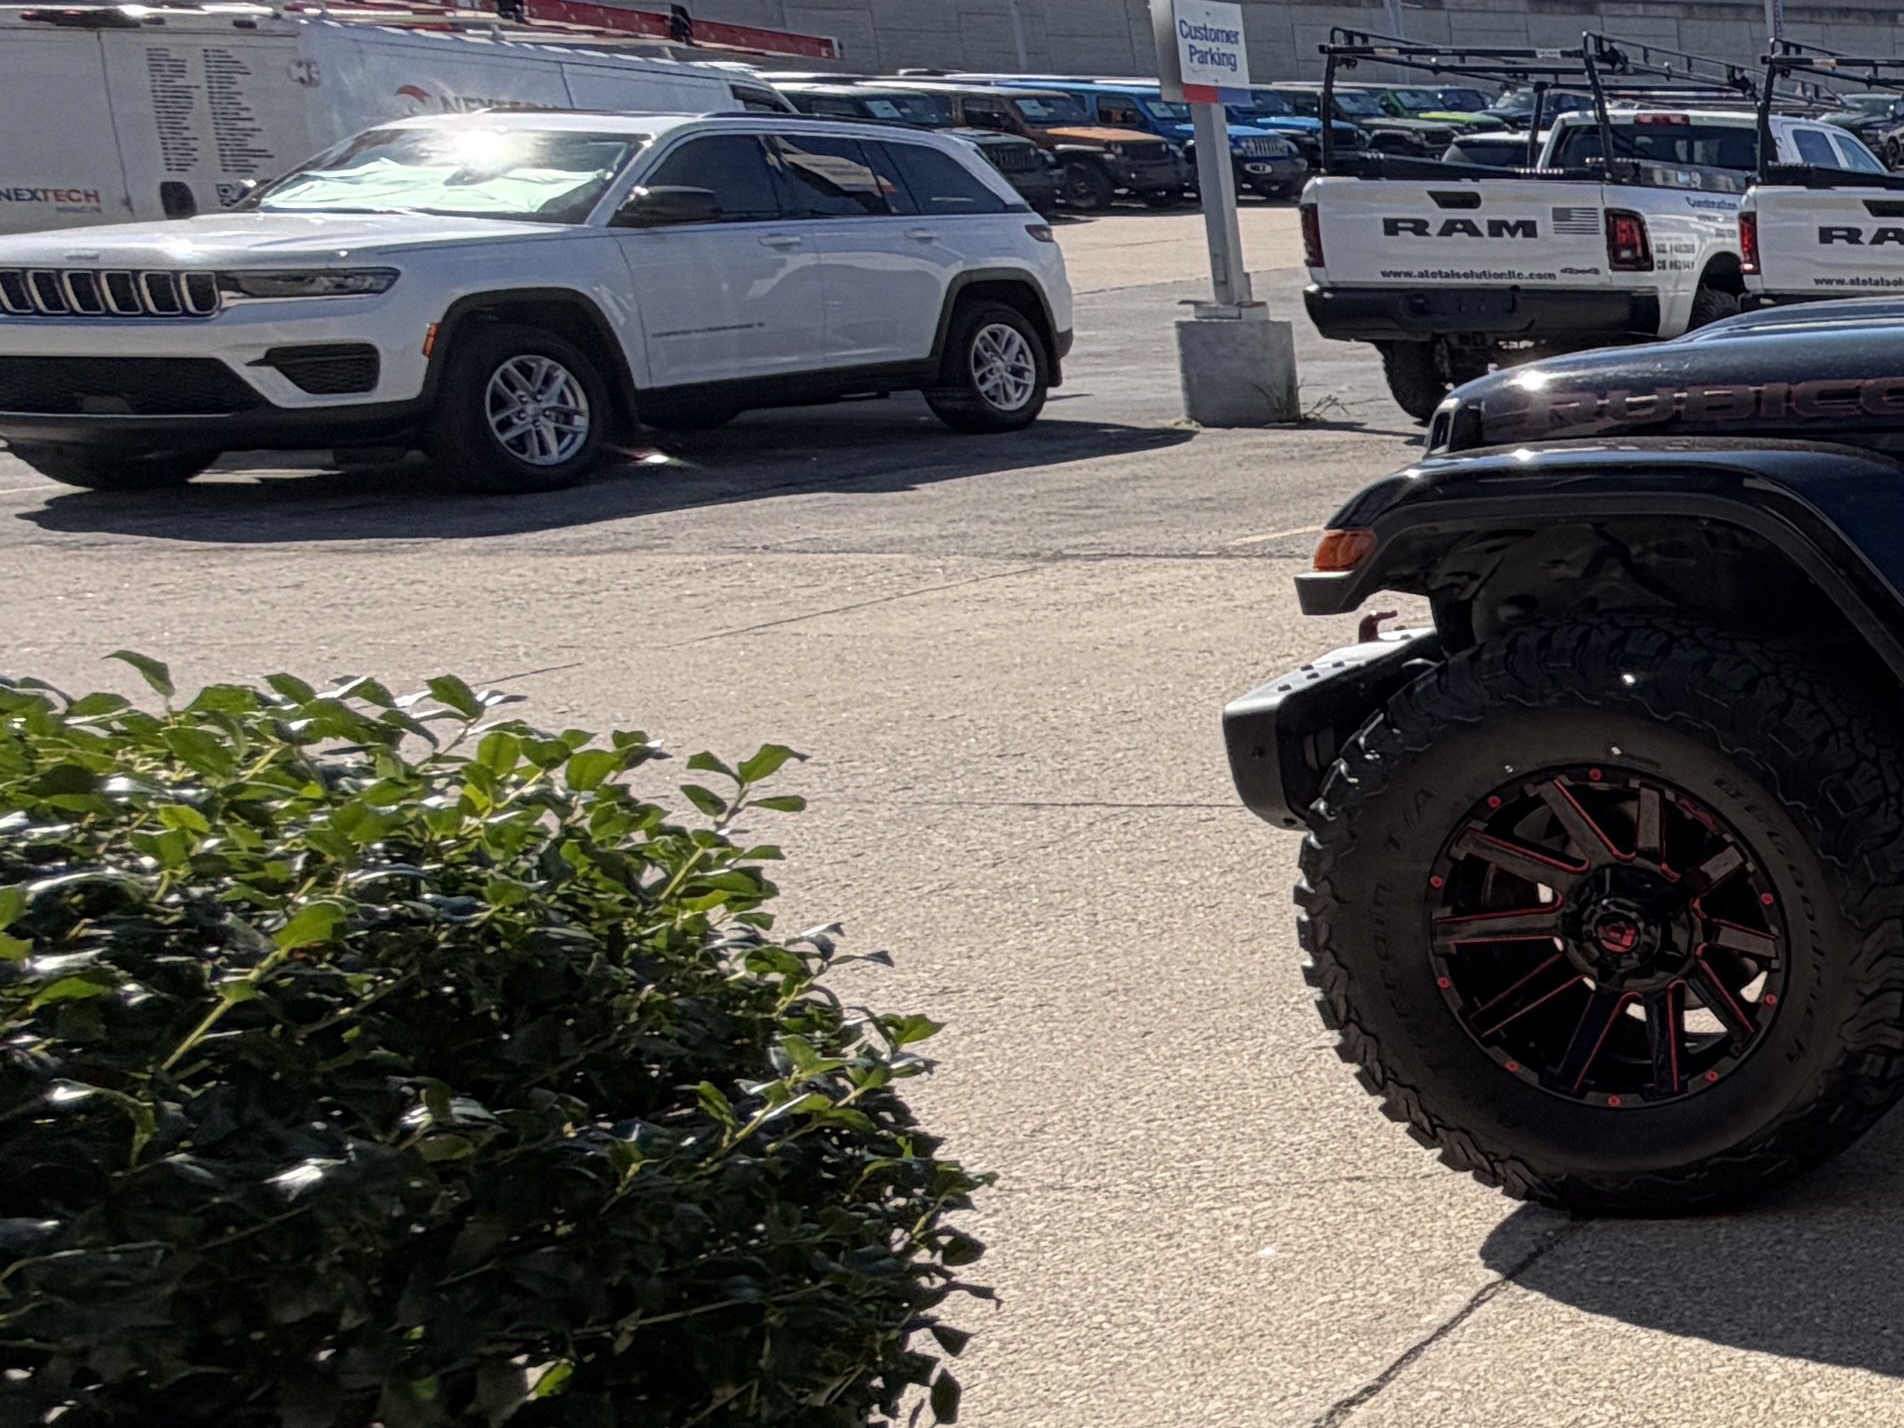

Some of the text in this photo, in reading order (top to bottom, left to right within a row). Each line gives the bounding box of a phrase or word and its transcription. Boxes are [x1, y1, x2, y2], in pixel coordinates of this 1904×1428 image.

[1179, 19, 1239, 45] Customer
[1188, 44, 1238, 72] Parking
[0, 188, 100, 204] NEXTECH
[1382, 217, 1538, 239] RAM
